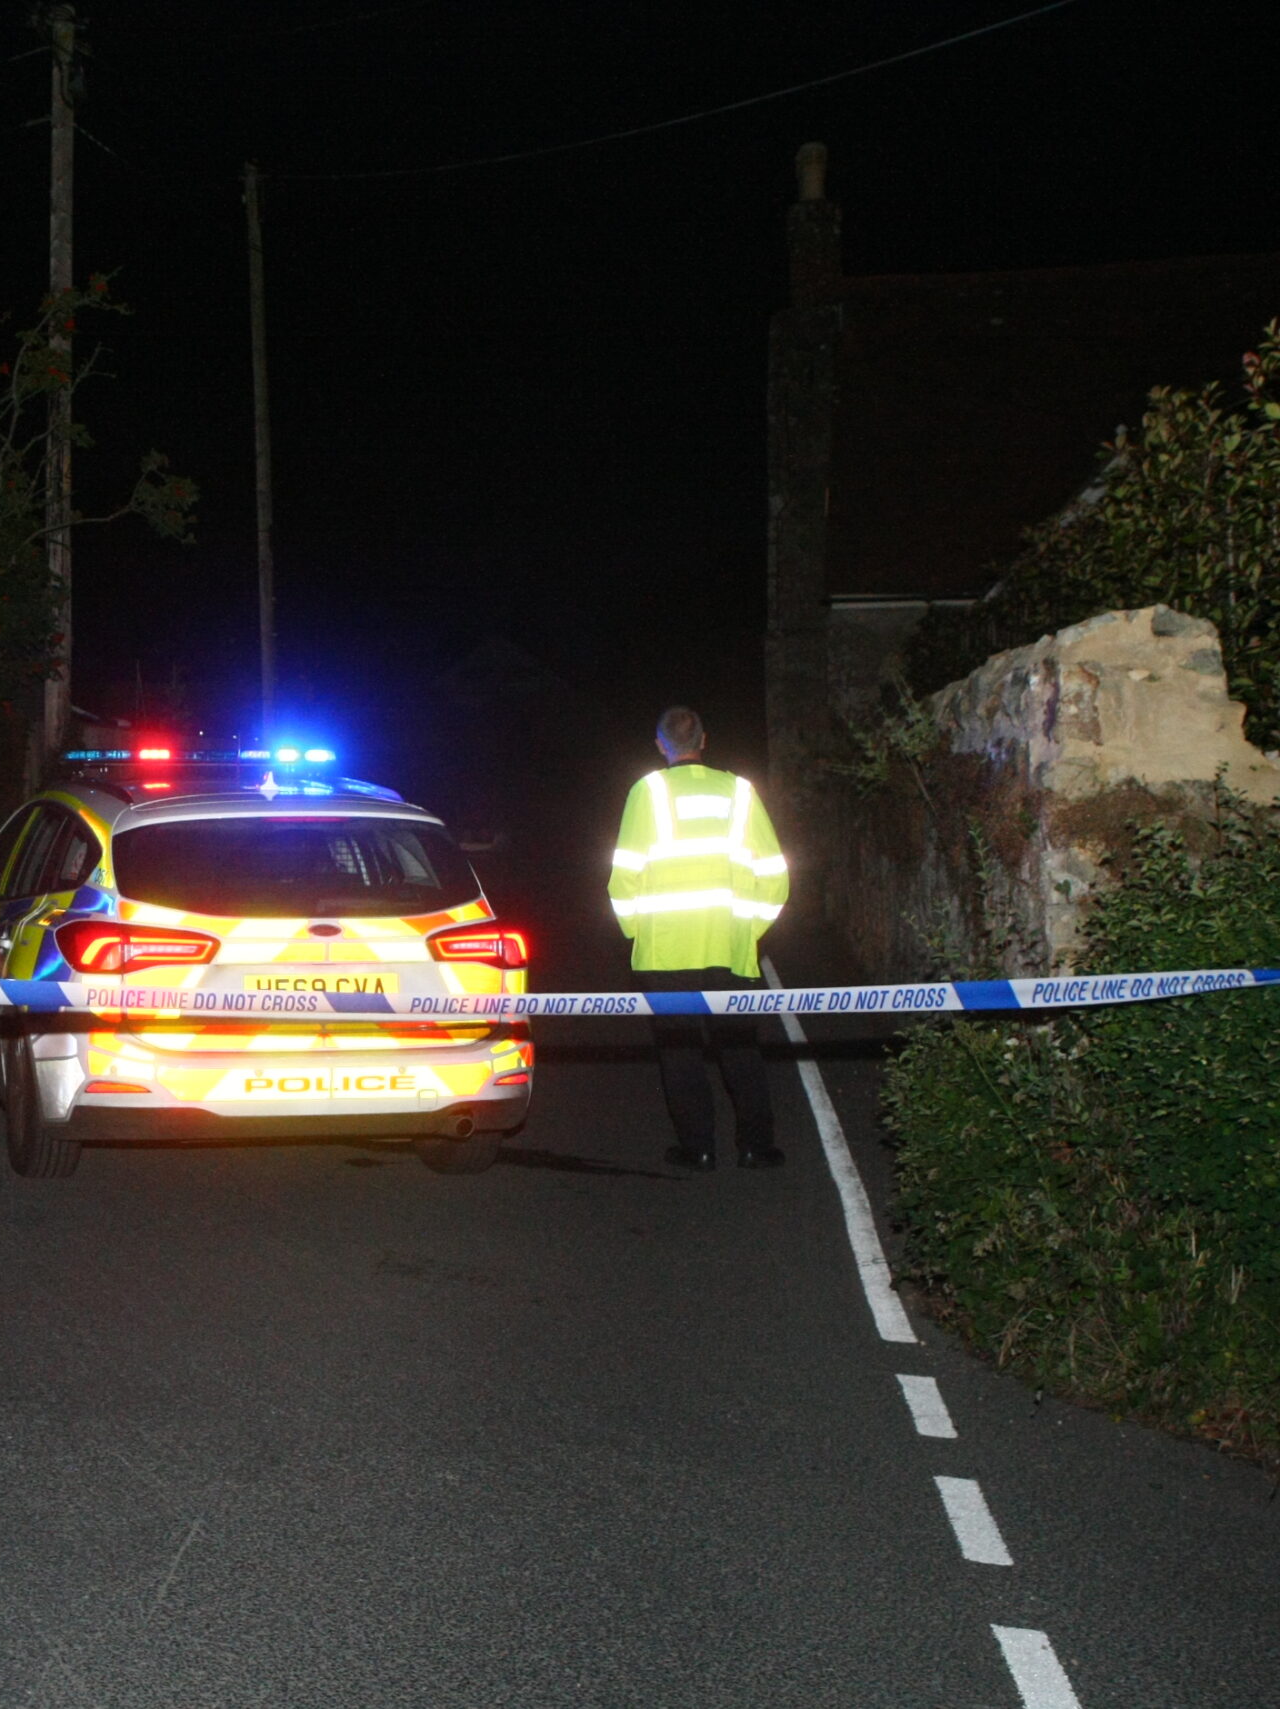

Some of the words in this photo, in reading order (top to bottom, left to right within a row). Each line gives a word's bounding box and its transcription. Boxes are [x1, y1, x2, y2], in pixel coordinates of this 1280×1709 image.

[86, 988, 145, 1008] POLICE
[151, 991, 188, 1009] LINE
[193, 992, 217, 1010] DO
[221, 993, 257, 1010] NOT
[261, 994, 318, 1011] CROSS
[725, 994, 784, 1012] POLICE
[786, 992, 825, 1011] LINE
[827, 991, 852, 1010] DO
[854, 990, 890, 1009] NOT
[892, 987, 947, 1008] CROSS
[1032, 981, 1090, 1004] POLICE
[1091, 978, 1128, 1001] LINE
[1130, 977, 1153, 998] DO
[1156, 975, 1190, 997] NOT
[409, 997, 469, 1013] POLICE
[473, 997, 512, 1014] LINE
[514, 997, 540, 1014] DO
[542, 997, 579, 1014] NOT
[581, 997, 638, 1014] CROSS
[244, 1075, 417, 1093] POLICE
